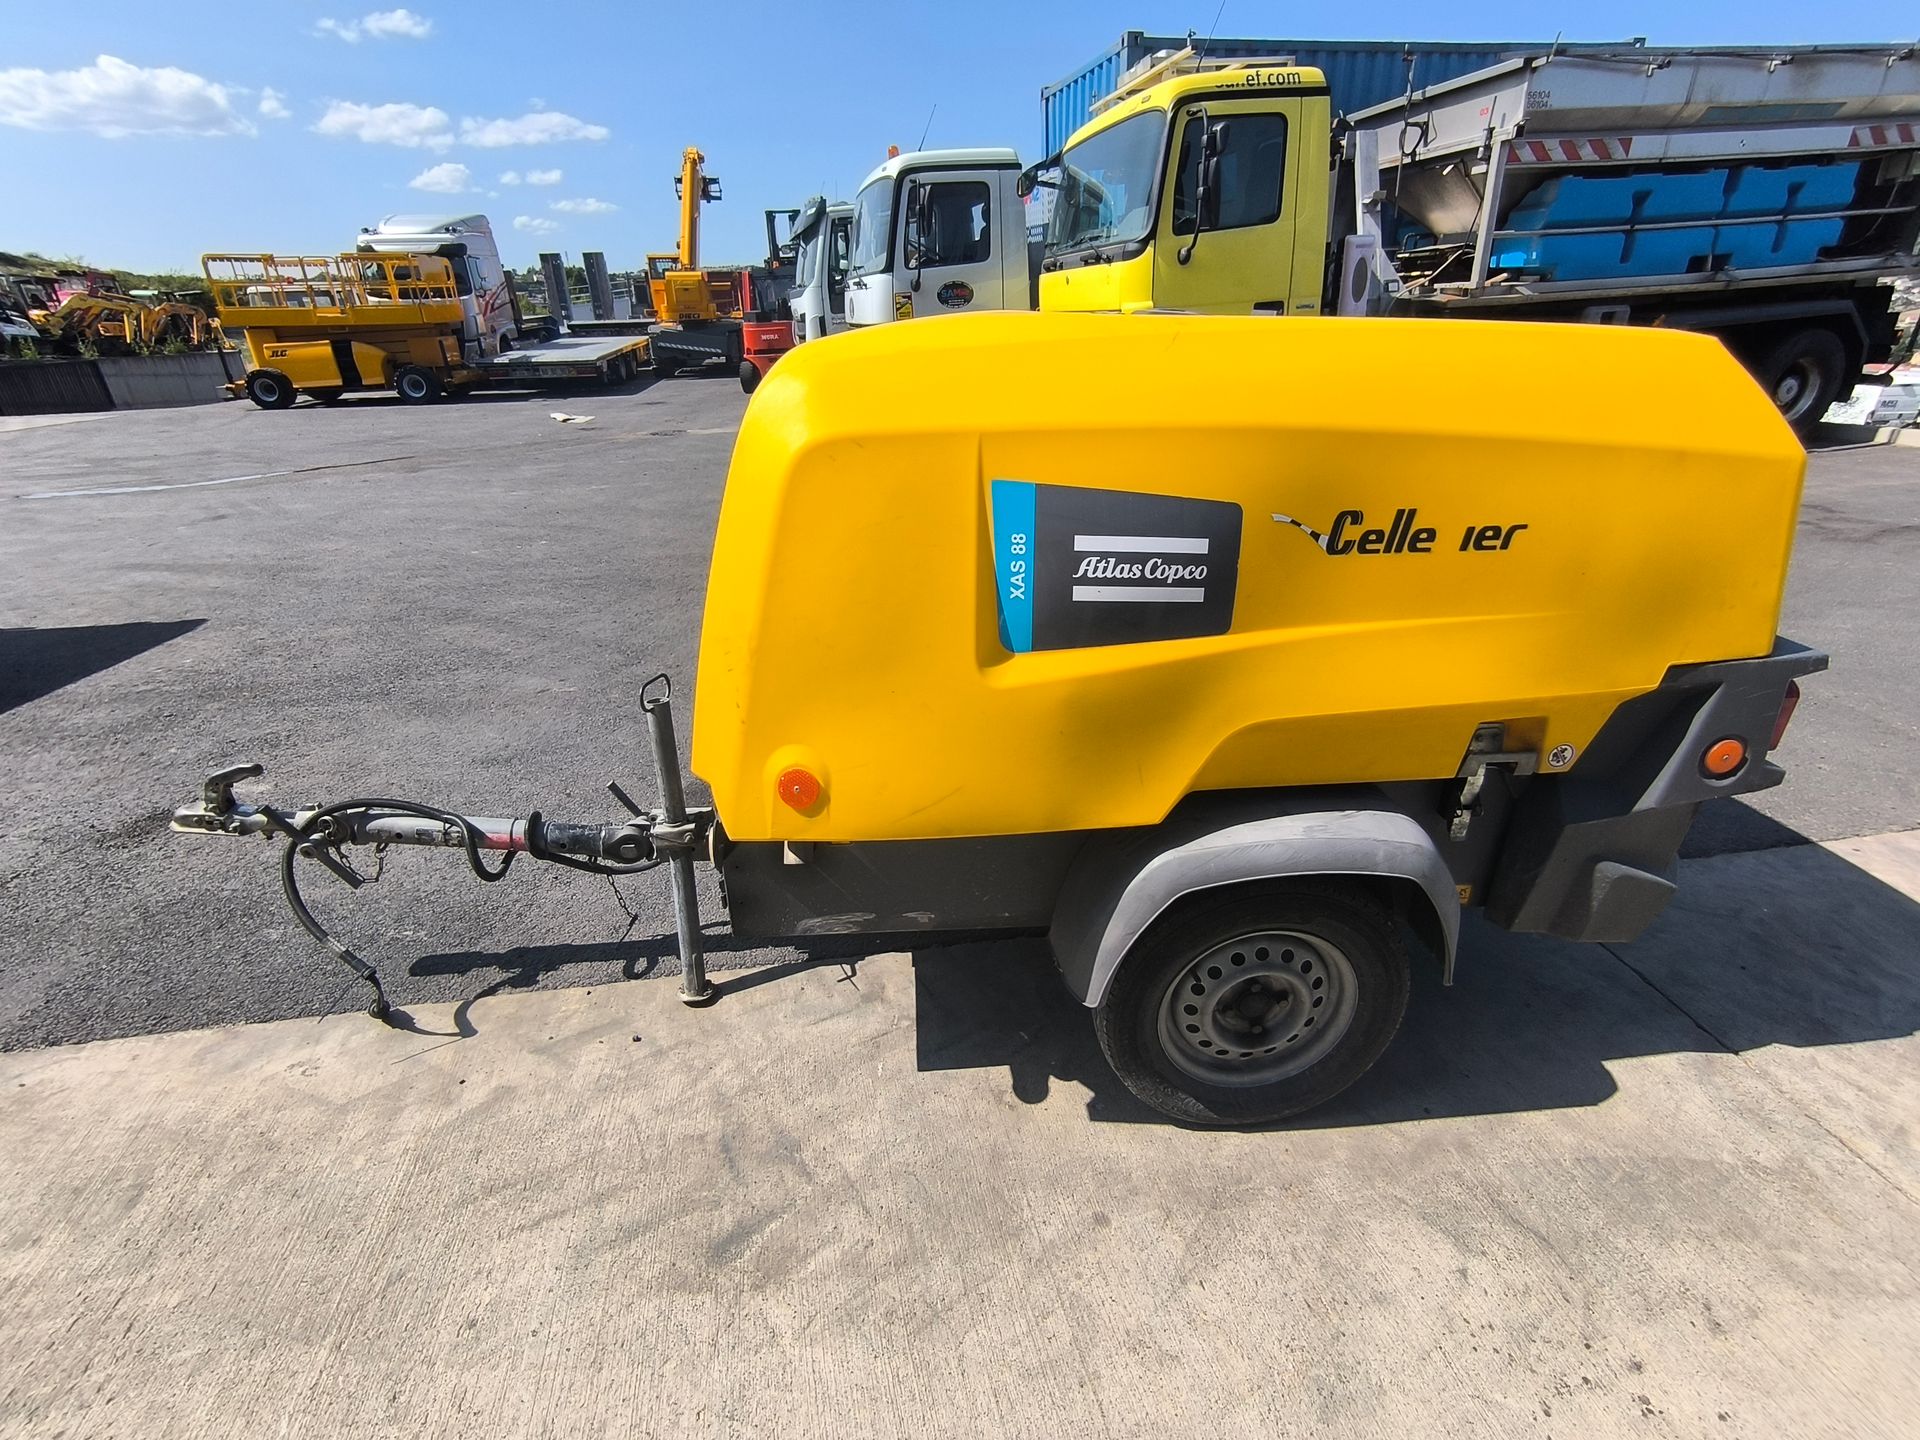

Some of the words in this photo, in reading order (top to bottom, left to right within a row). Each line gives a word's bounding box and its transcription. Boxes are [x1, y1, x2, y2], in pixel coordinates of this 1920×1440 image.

[270, 349, 288, 358] JLG
[1011, 532, 1027, 555] 88
[1009, 560, 1026, 600] XAS
[1072, 556, 1143, 579] Atlas
[1144, 557, 1208, 584] Copco
